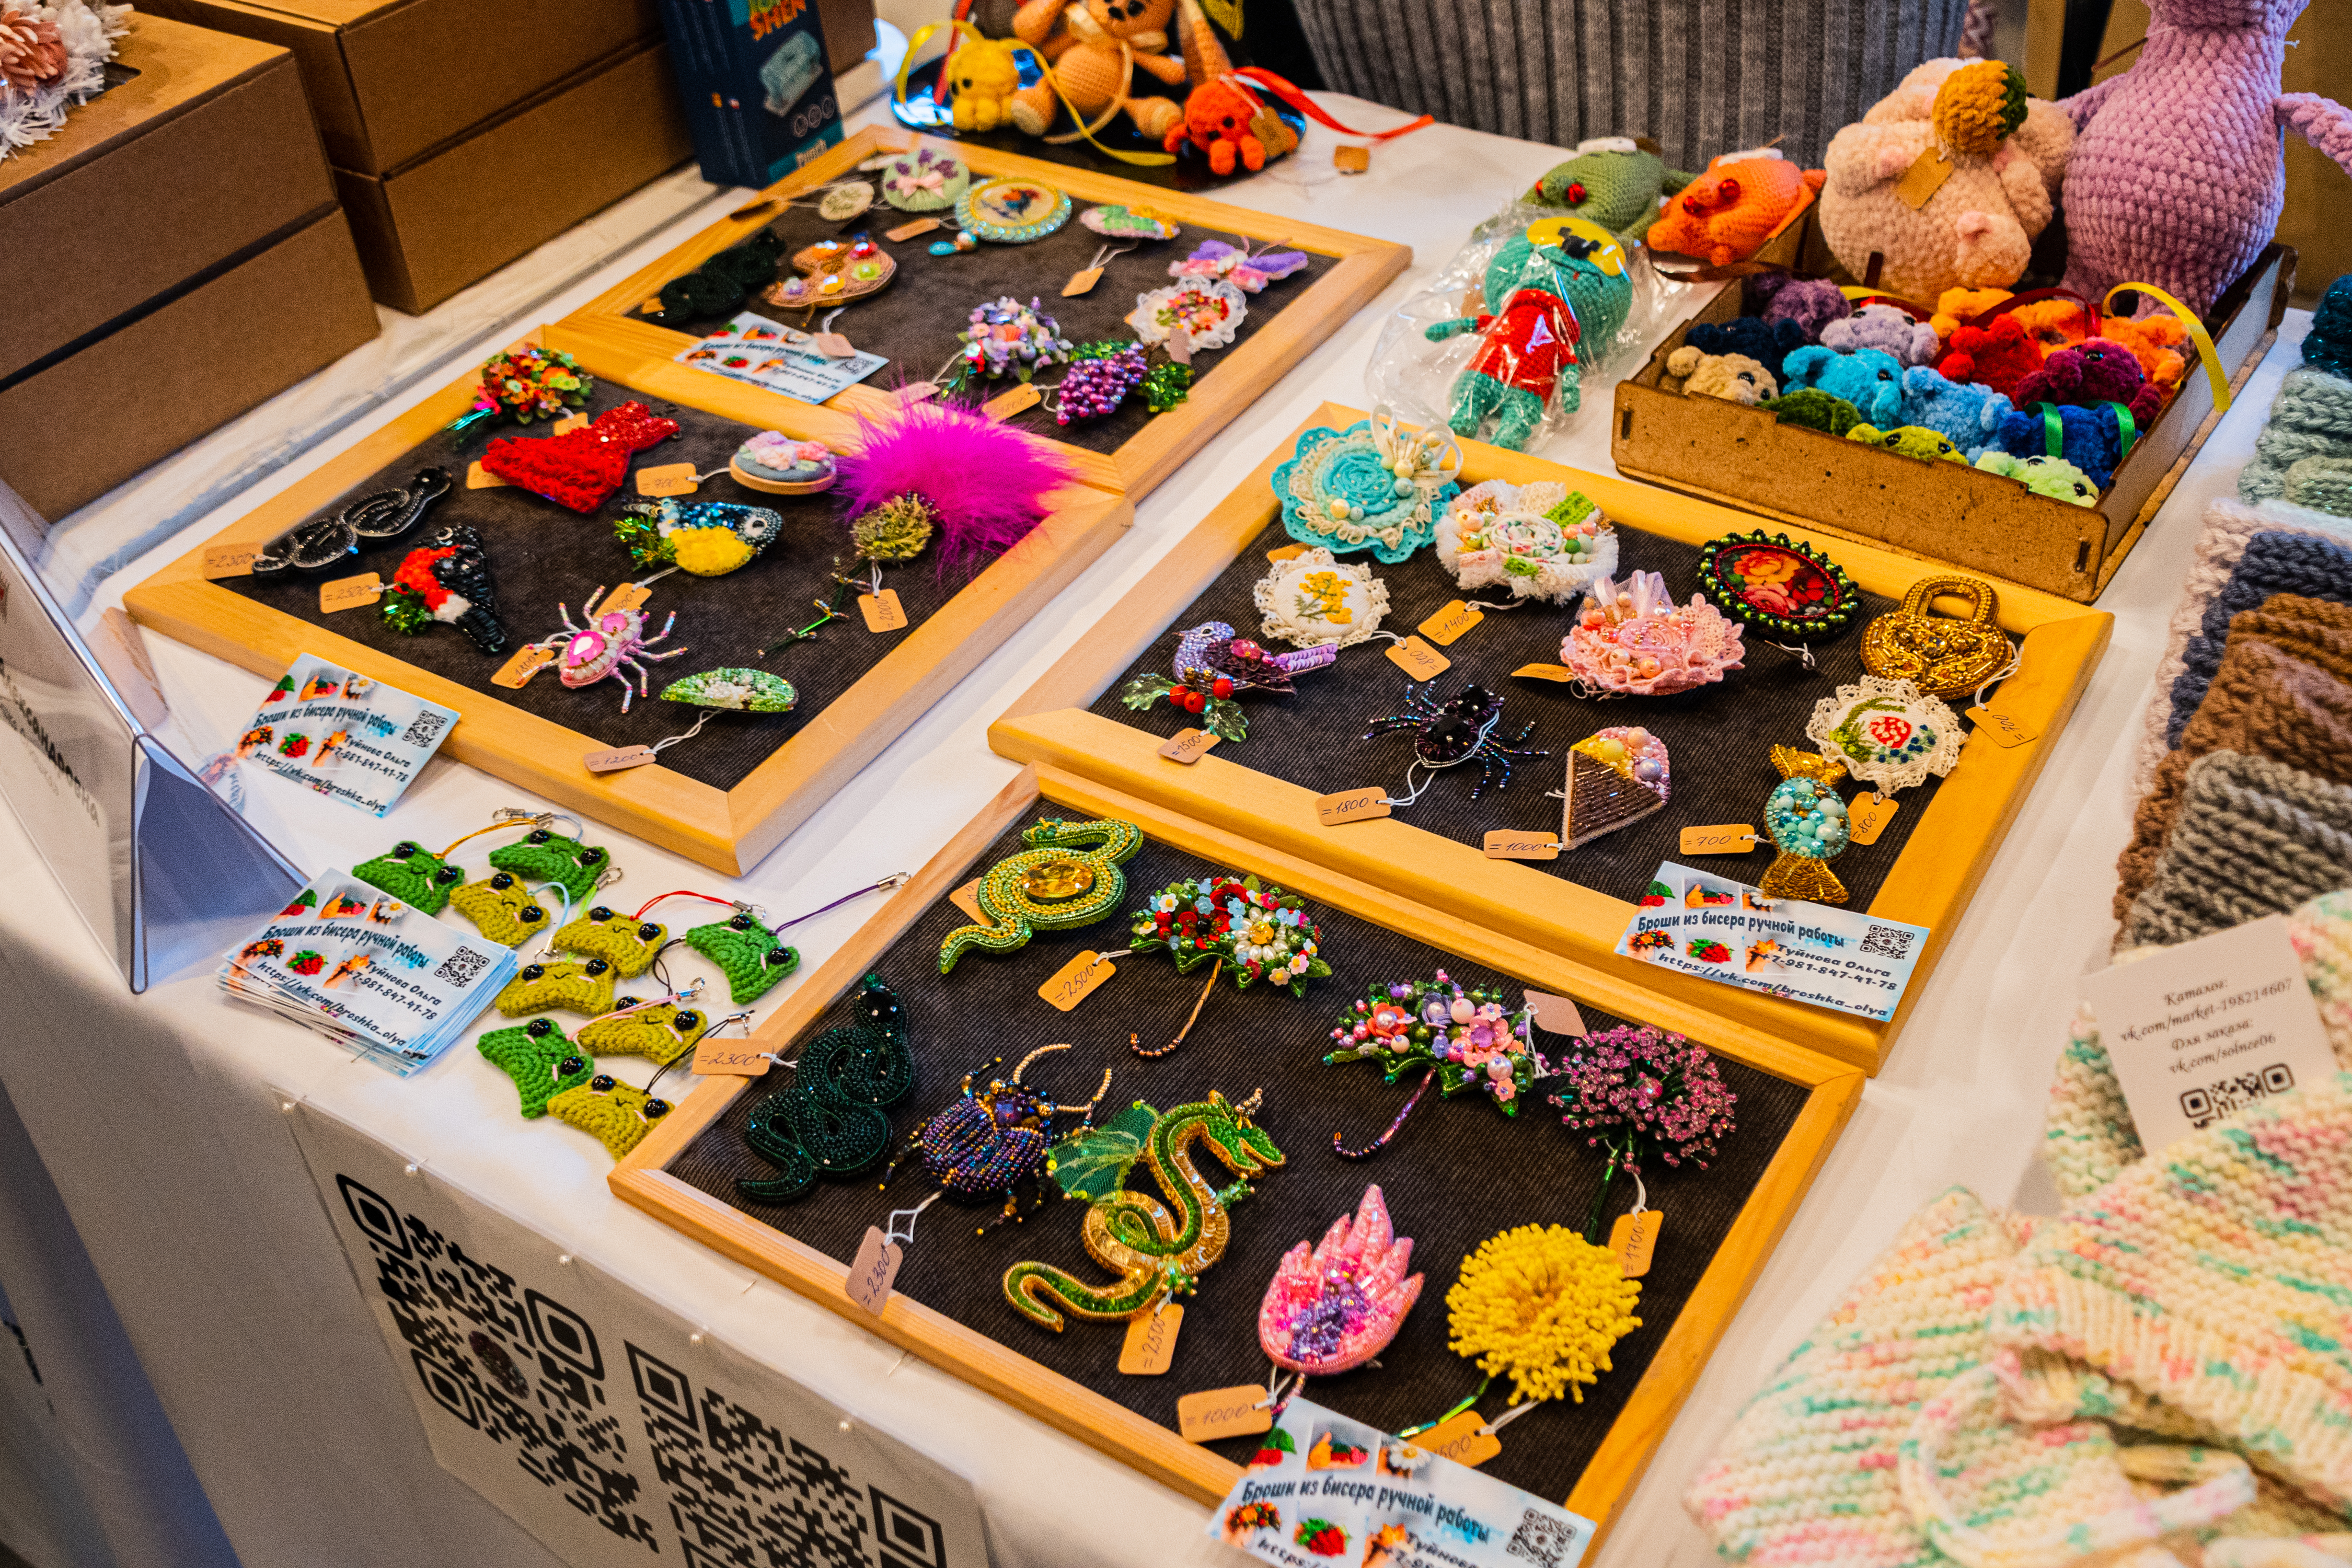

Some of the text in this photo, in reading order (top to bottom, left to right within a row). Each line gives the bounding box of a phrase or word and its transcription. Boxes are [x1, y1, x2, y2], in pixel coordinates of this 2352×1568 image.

[262, 922, 429, 969] Броши из бисера ручной работы
[1638, 911, 1844, 947] Броши из бисера ручной работы
[366, 960, 442, 1006] Туйнова Ольга
[1761, 953, 1897, 990] +7-981-847-41-78
[1778, 943, 1892, 977] Туйнова Ольга
[258, 962, 407, 1046] https://vk.com/broshka_olya
[347, 970, 437, 1020] +7-981-847-41-78
[1658, 953, 1888, 1016] https://vk.com/broshka_olya
[1242, 1473, 1490, 1544] Броши из бисера ручной работы
